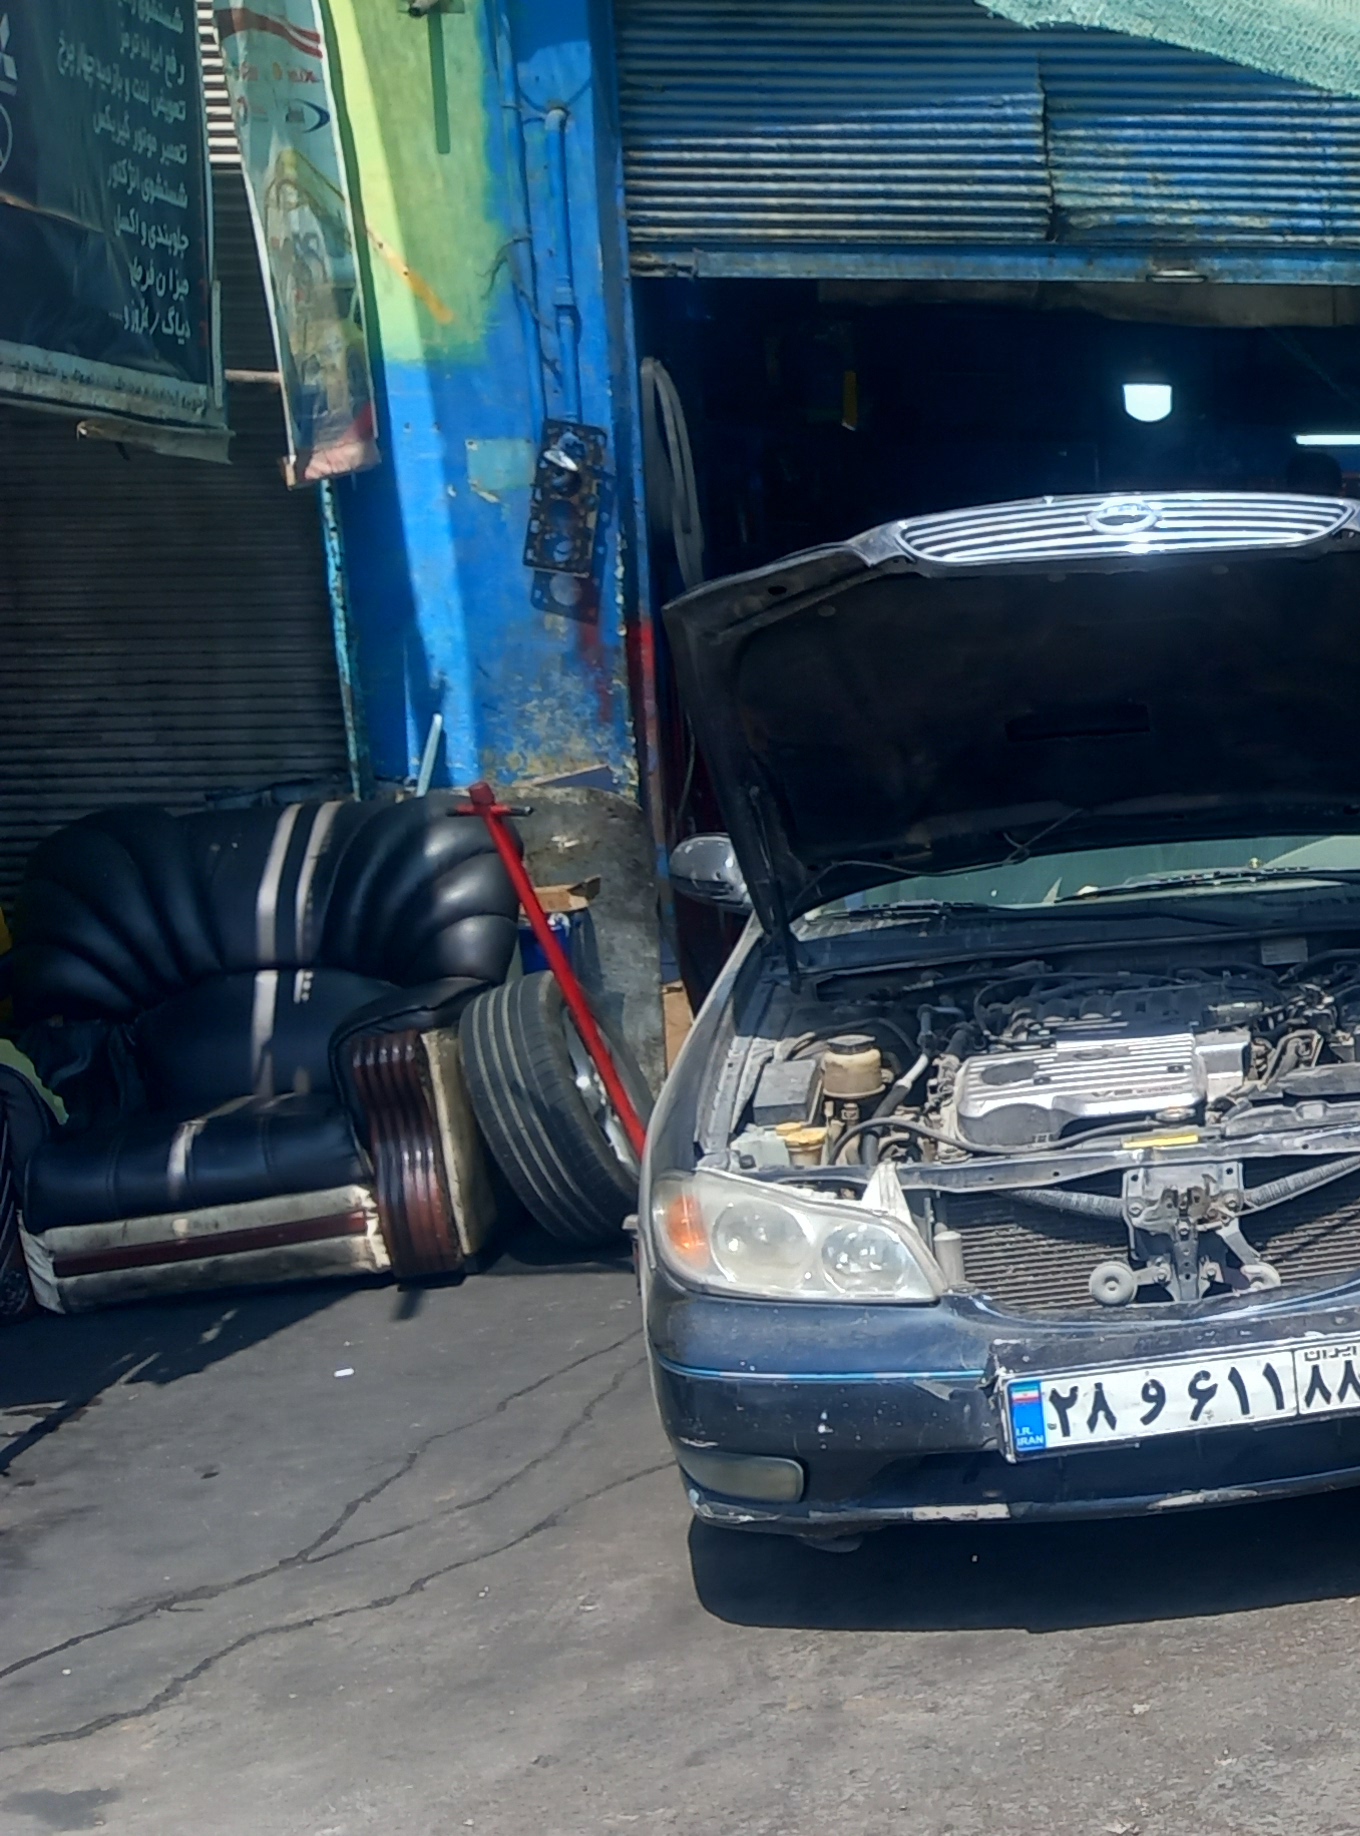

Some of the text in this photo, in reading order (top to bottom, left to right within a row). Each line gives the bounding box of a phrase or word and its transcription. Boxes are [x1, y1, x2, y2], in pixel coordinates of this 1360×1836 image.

[160, 143, 188, 166] تعمیر
[161, 305, 191, 345] دیاگ
[1304, 1345, 1357, 1362] ایران
[1016, 1434, 1044, 1447] IRAN
